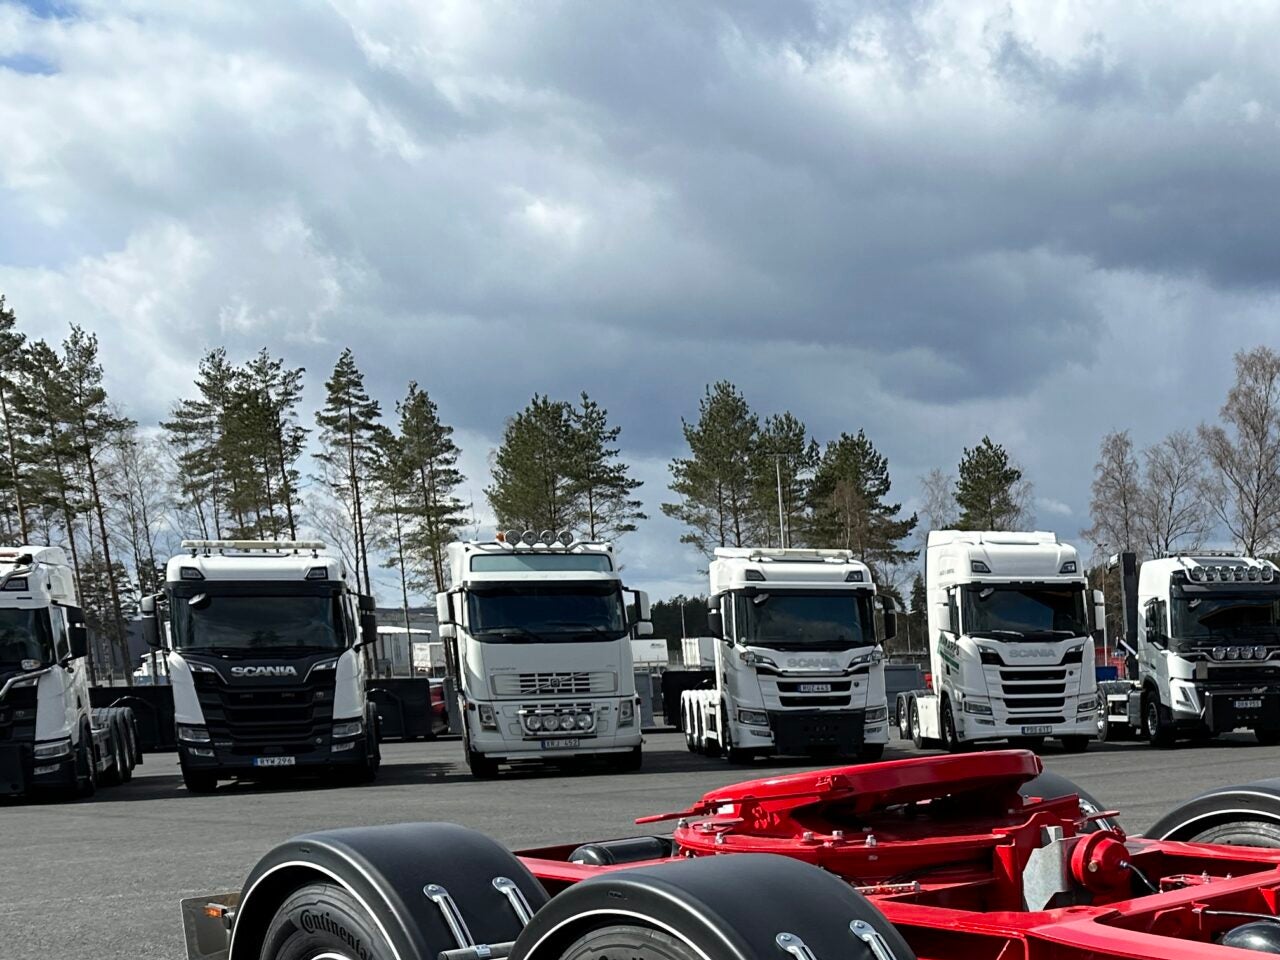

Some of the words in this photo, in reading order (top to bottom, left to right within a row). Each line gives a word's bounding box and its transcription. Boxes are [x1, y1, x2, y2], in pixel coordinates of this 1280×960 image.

[1009, 649, 1056, 658] SCANIA
[787, 658, 841, 669] SCANIA
[231, 666, 299, 677] SCANIA
